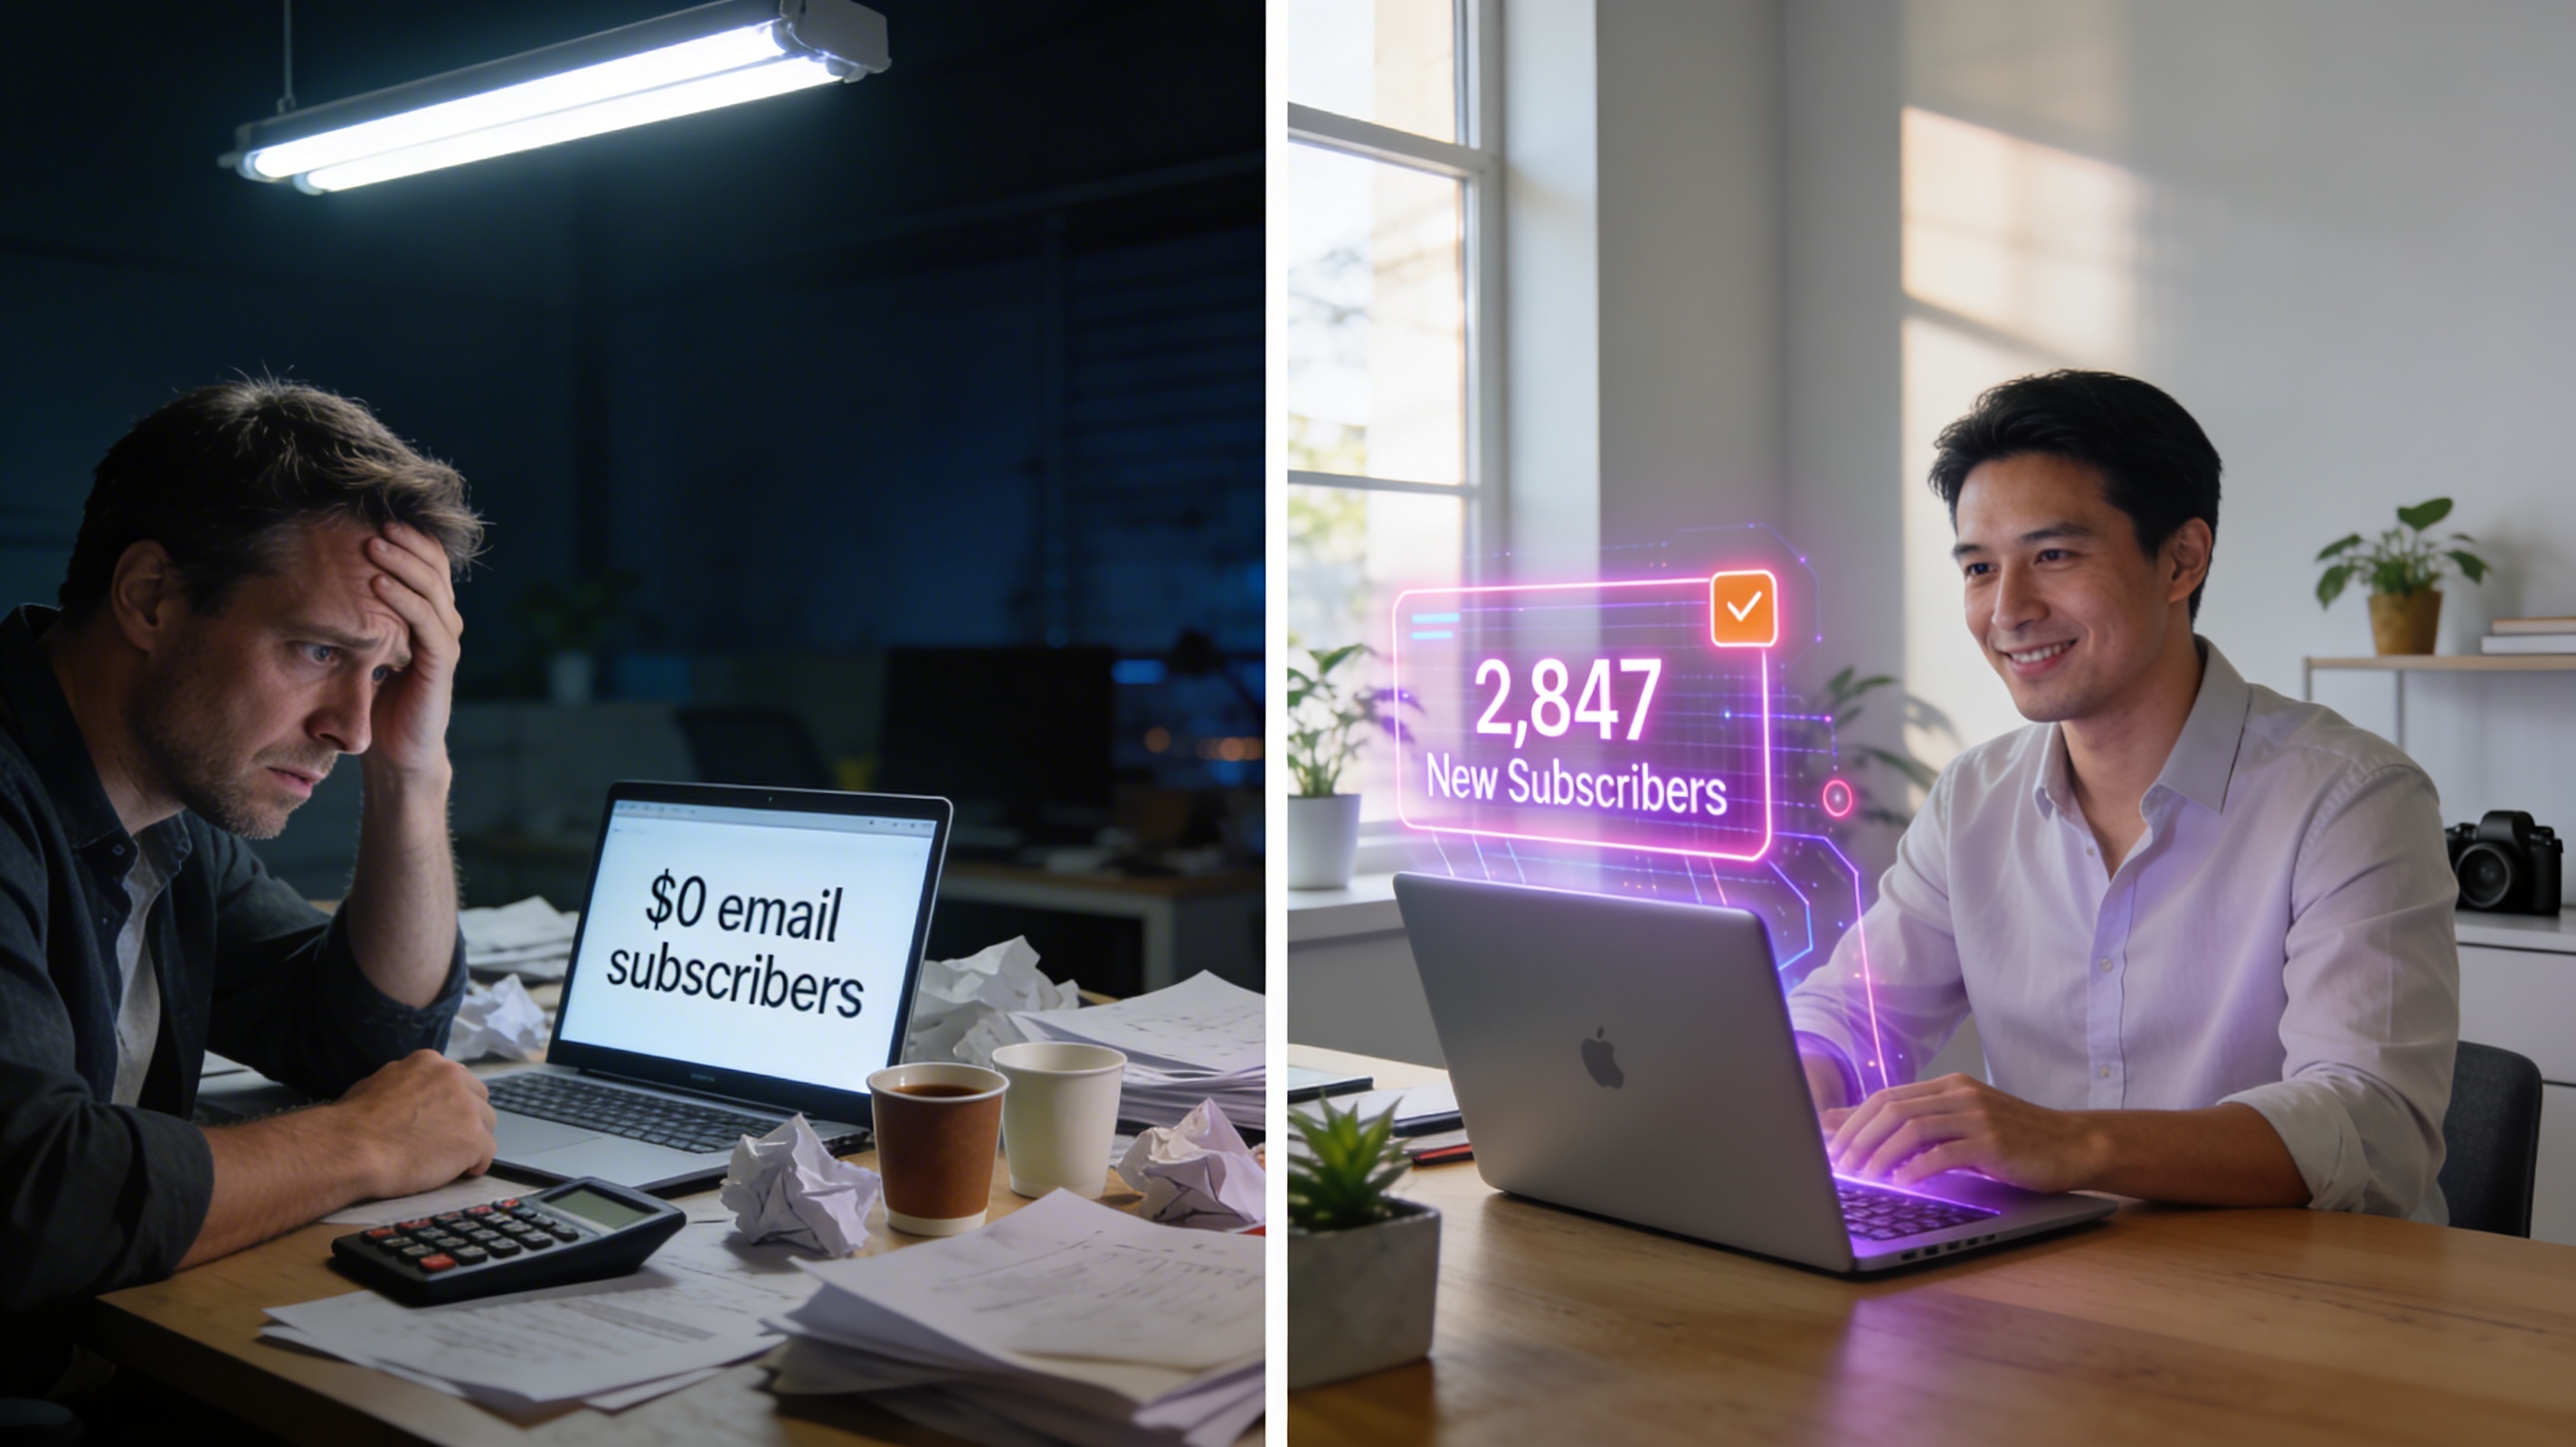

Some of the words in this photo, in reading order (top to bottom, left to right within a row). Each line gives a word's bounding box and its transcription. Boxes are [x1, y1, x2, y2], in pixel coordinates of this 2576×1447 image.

[1474, 657, 1662, 750] 2,847
[1426, 752, 1498, 800] New
[1508, 757, 1728, 817] Subscribers
[646, 868, 707, 931] $0
[718, 887, 844, 943] email
[607, 941, 865, 1019] subscribers
